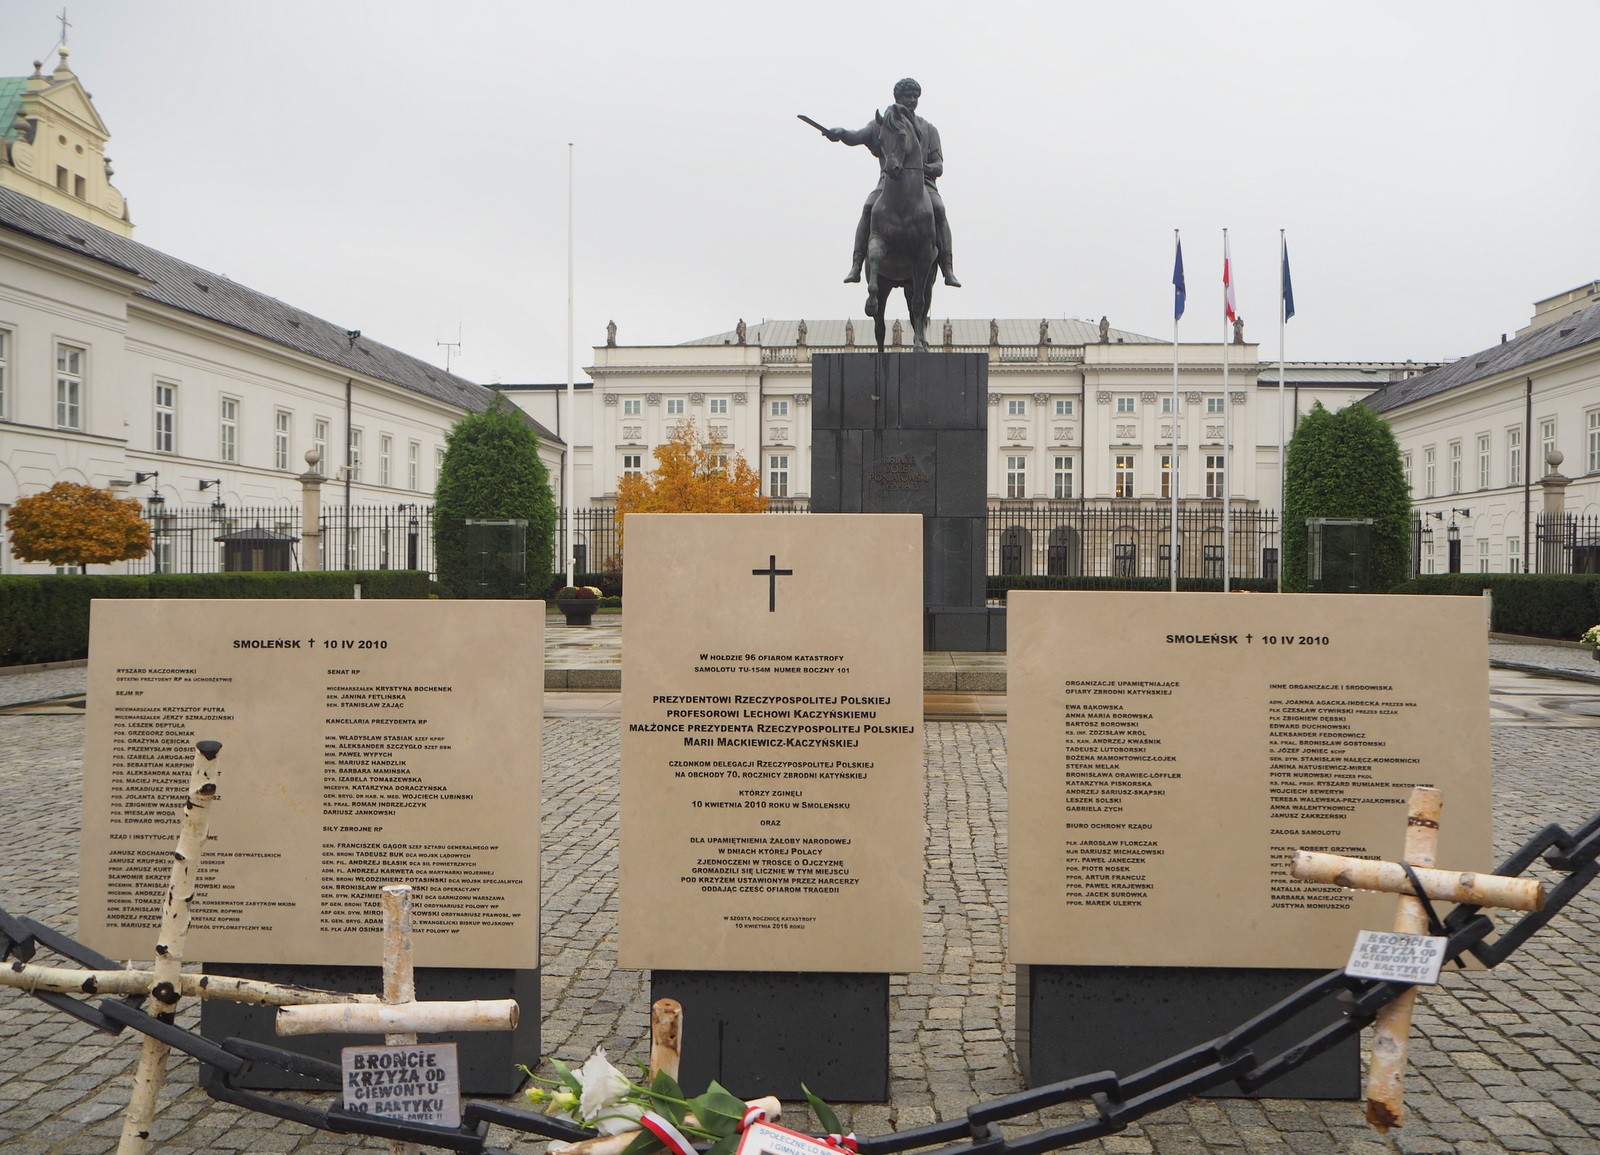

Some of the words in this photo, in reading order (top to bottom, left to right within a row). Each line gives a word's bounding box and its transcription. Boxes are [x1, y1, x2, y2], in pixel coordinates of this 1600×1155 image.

[324, 640, 338, 648] 10
[341, 640, 354, 649] IV
[358, 640, 388, 649] 2010
[1263, 636, 1277, 644] 10
[1281, 636, 1294, 644] IV
[1299, 636, 1330, 645] 2010
[653, 696, 732, 704] PREZYDENTOWI
[734, 696, 838, 704] RZECZYPOSPOLITEJ
[840, 696, 891, 705] POLSKIEJ
[667, 710, 740, 718] PROFESOROWI
[793, 709, 877, 719] KACZYŃSKIEMU
[629, 723, 685, 732] MAŁŻONCE
[687, 724, 754, 732] PREZYDENTA
[757, 725, 861, 733] RZECZYPOSPOLITEJ
[863, 725, 915, 734] POLSKIEJ
[684, 738, 714, 746] MARII
[717, 737, 859, 747] MACKIEWICZ-KACZYŃSKIEJ
[819, 771, 868, 779] KATYŃSKIEJ
[801, 801, 850, 809] SMOLEŃSKU
[707, 837, 768, 845] UPAMIĘTNIENIA
[769, 836, 800, 844] ŻAŁOBY
[758, 847, 789, 855] KTÓREJ
[801, 860, 844, 868] OJCZYZNĘ
[741, 868, 754, 876] SIĘ
[1421, 949, 1436, 957] OD
[1353, 960, 1369, 968] DO
[426, 1068, 446, 1082] OD
[355, 1083, 438, 1100] GIEWONTU
[349, 1102, 368, 1114] DO
[760, 1128, 806, 1150] SPOŁECZNE
[808, 1144, 819, 1154] LO
[775, 1144, 806, 1155] GIMNA
